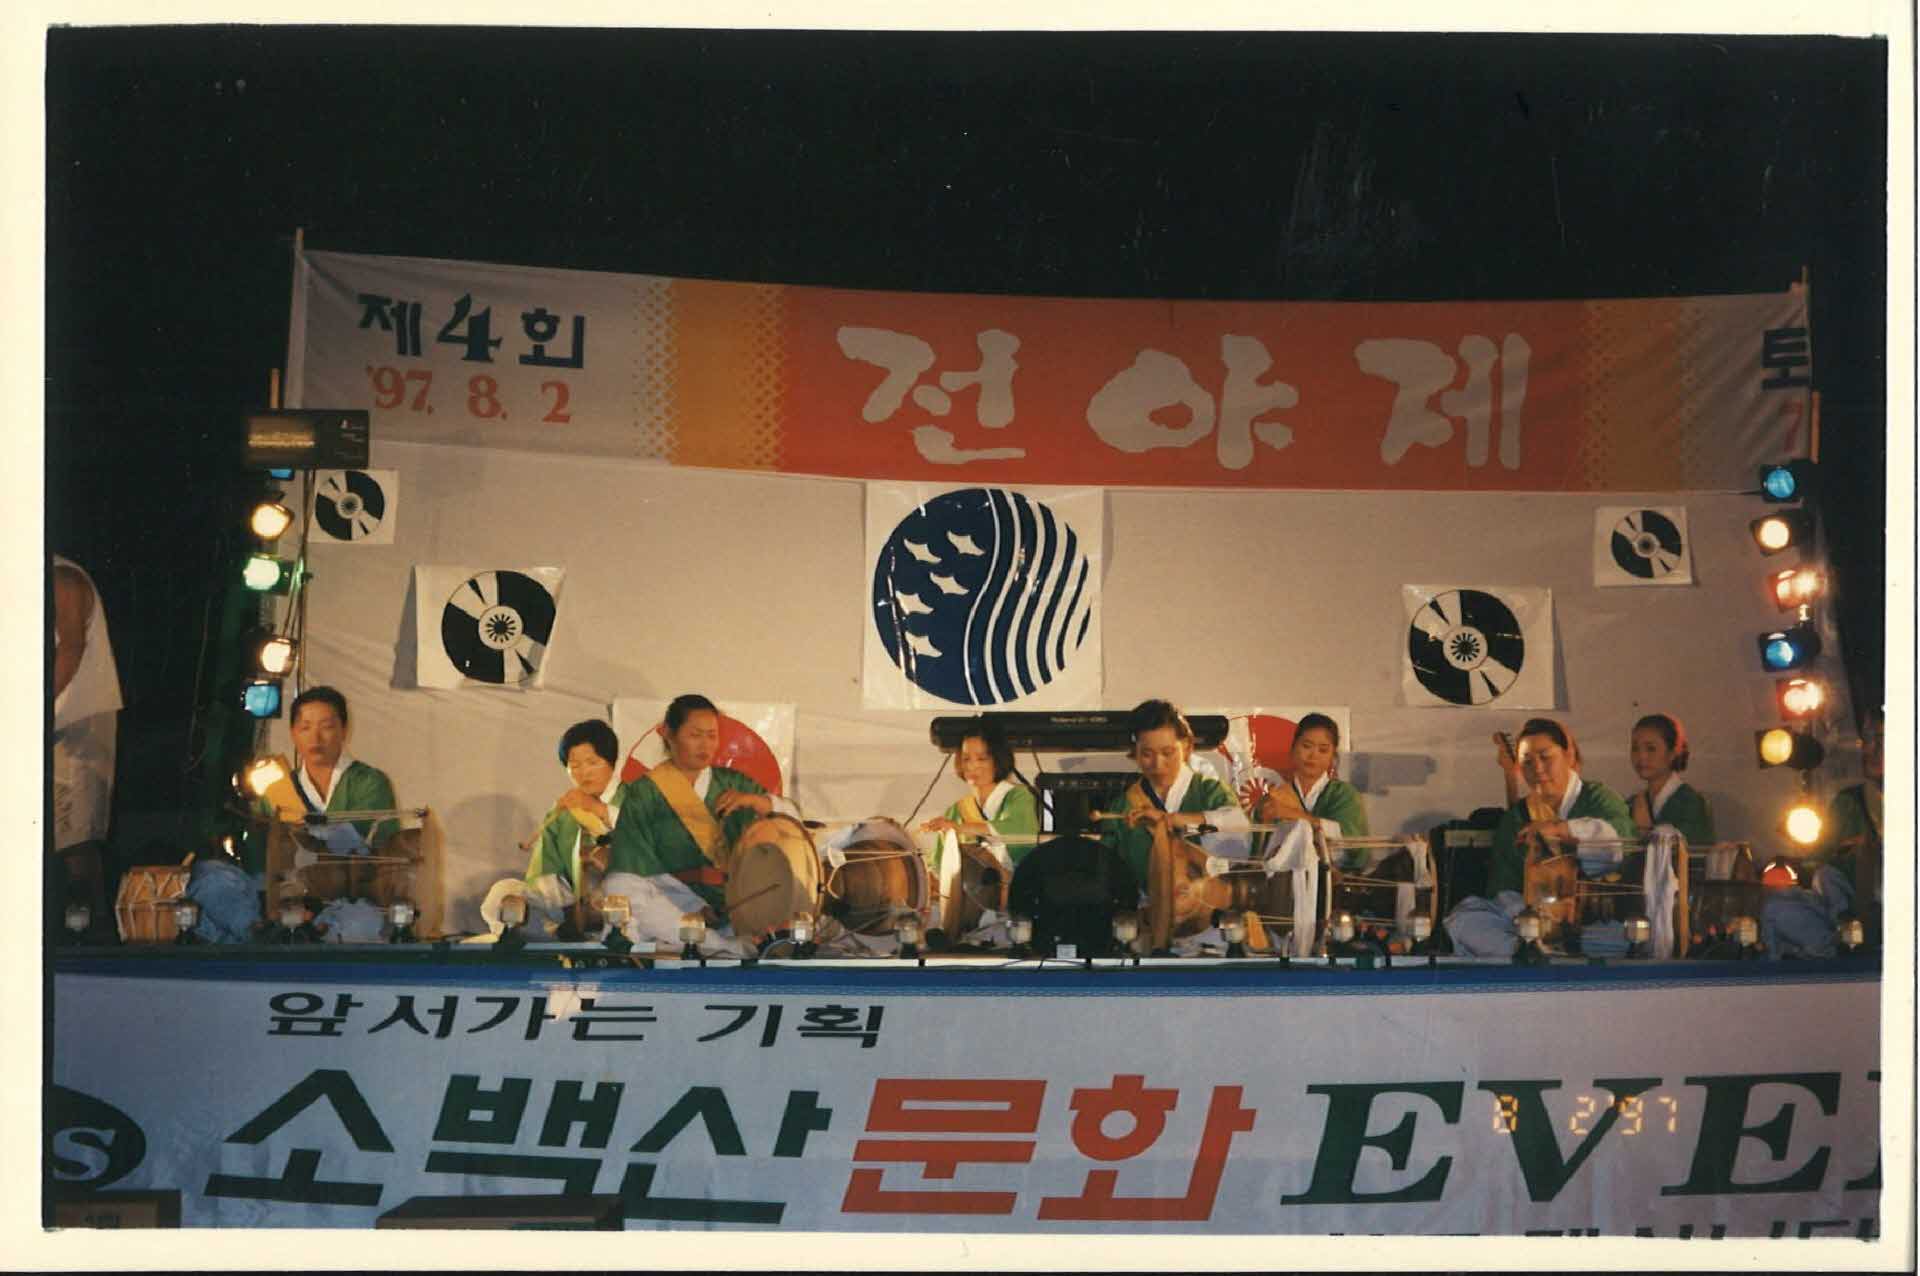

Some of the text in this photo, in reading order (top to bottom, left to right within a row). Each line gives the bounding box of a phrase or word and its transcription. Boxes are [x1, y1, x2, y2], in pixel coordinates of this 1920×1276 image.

[358, 293, 585, 370] 제4회
[541, 380, 571, 423] 2
[837, 325, 1531, 470] 전야제
[267, 991, 884, 1048] 앞서가는 기획
[840, 1074, 1257, 1221] 문화
[1280, 1071, 1882, 1206] EVE
